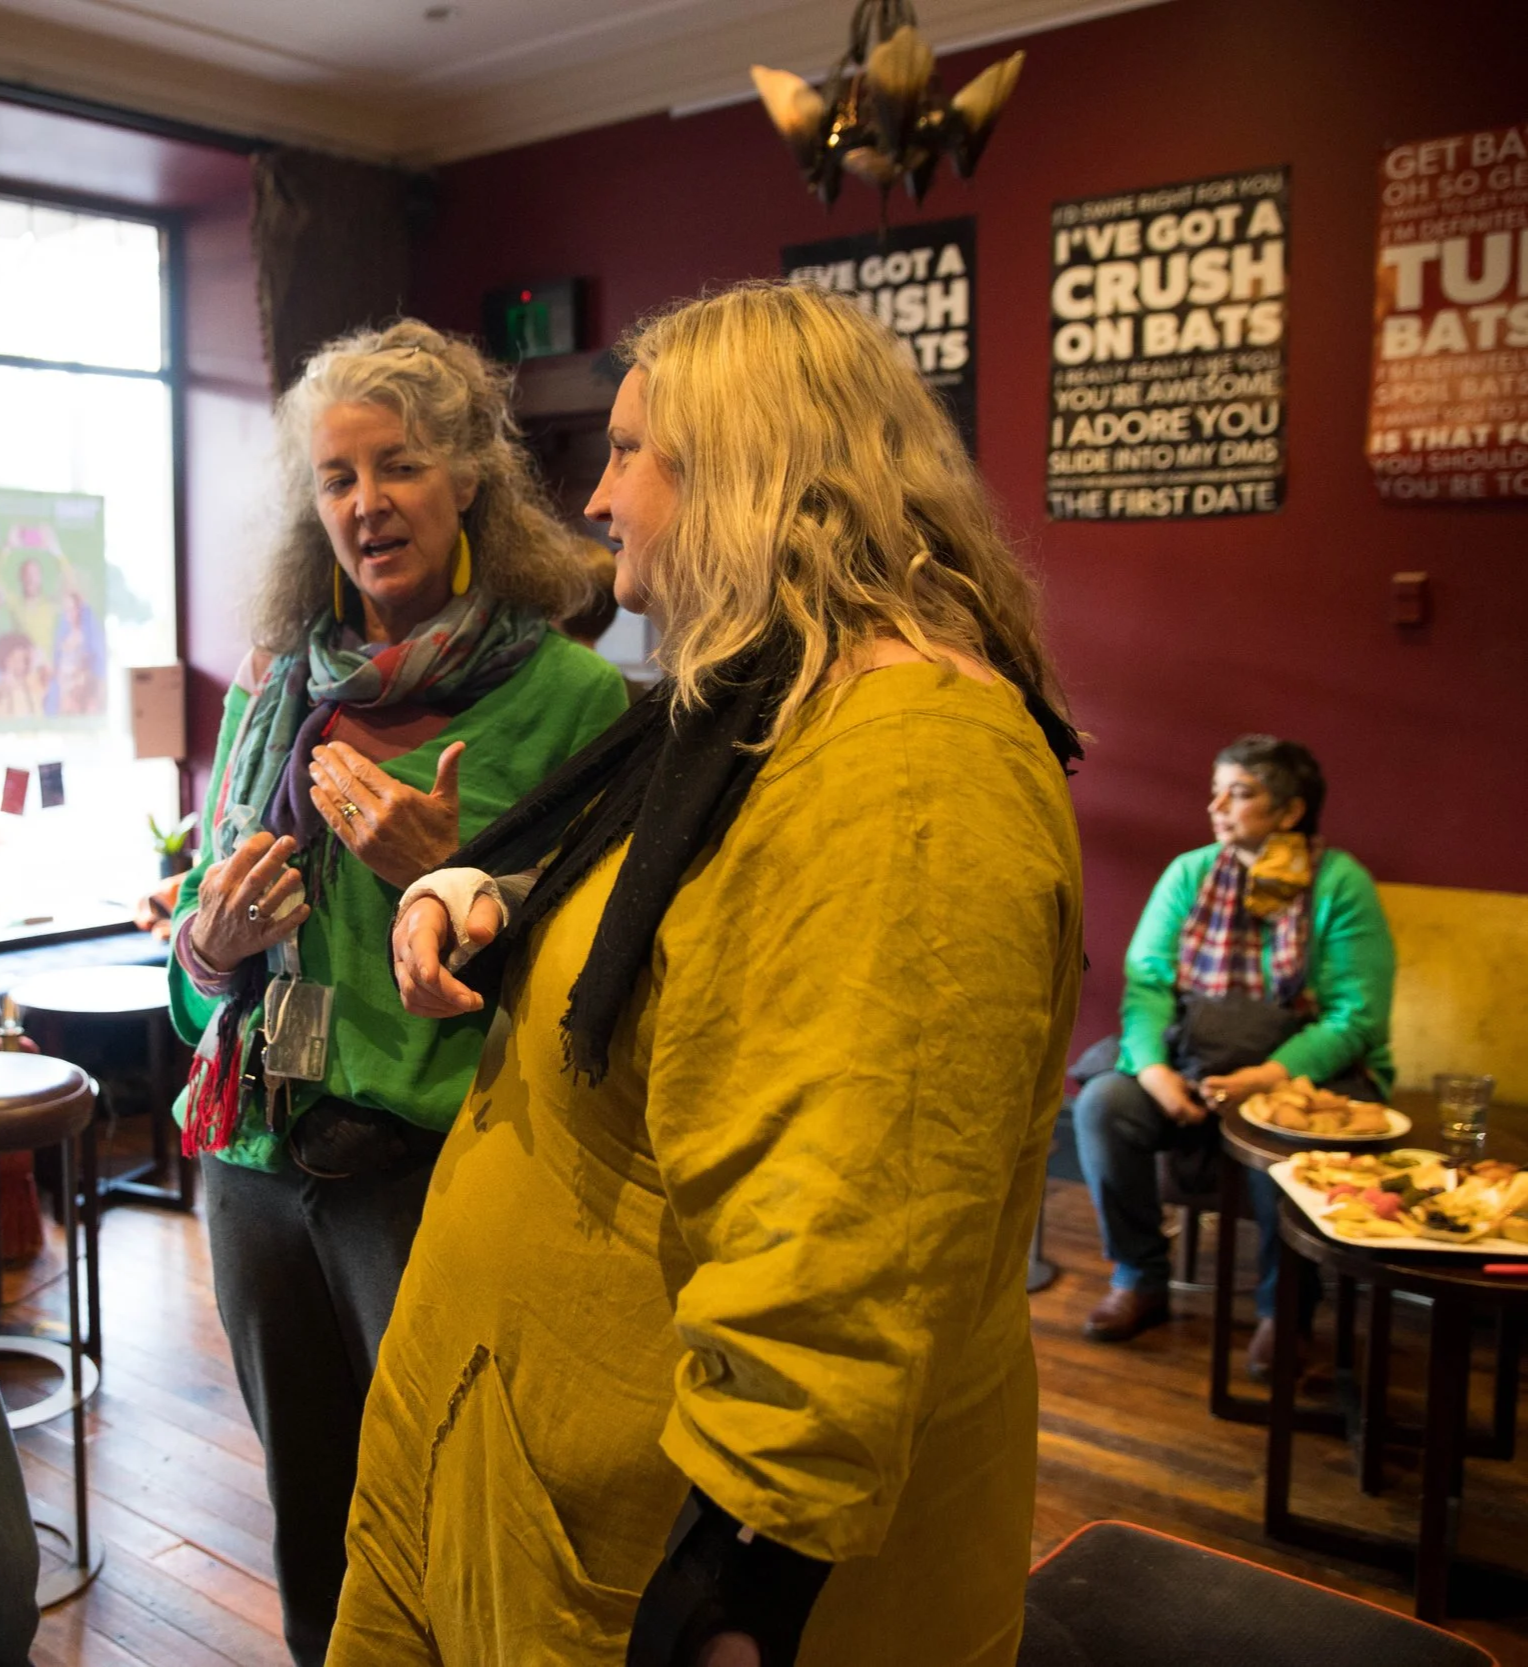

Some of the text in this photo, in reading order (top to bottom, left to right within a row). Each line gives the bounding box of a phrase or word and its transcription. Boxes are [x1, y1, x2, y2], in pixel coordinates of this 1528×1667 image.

[1385, 126, 1528, 180] GET BA
[1239, 172, 1284, 196] YOU
[1437, 169, 1480, 198] SO
[1054, 198, 1284, 266] I'VE GOT A
[860, 247, 933, 287] GOT
[936, 243, 966, 277] A
[1052, 239, 1285, 320] CRUSH
[1053, 301, 1284, 365] ON BATS
[1381, 303, 1528, 360] BATS
[1145, 370, 1281, 403] AWESOME
[1053, 401, 1280, 448] I ADORE YOU
[1407, 423, 1491, 451] THAT
[1049, 448, 1110, 474] SLIDE
[1113, 444, 1175, 472] INTO
[1176, 440, 1218, 467] MY
[1049, 481, 1276, 518] THE FIRST DATE
